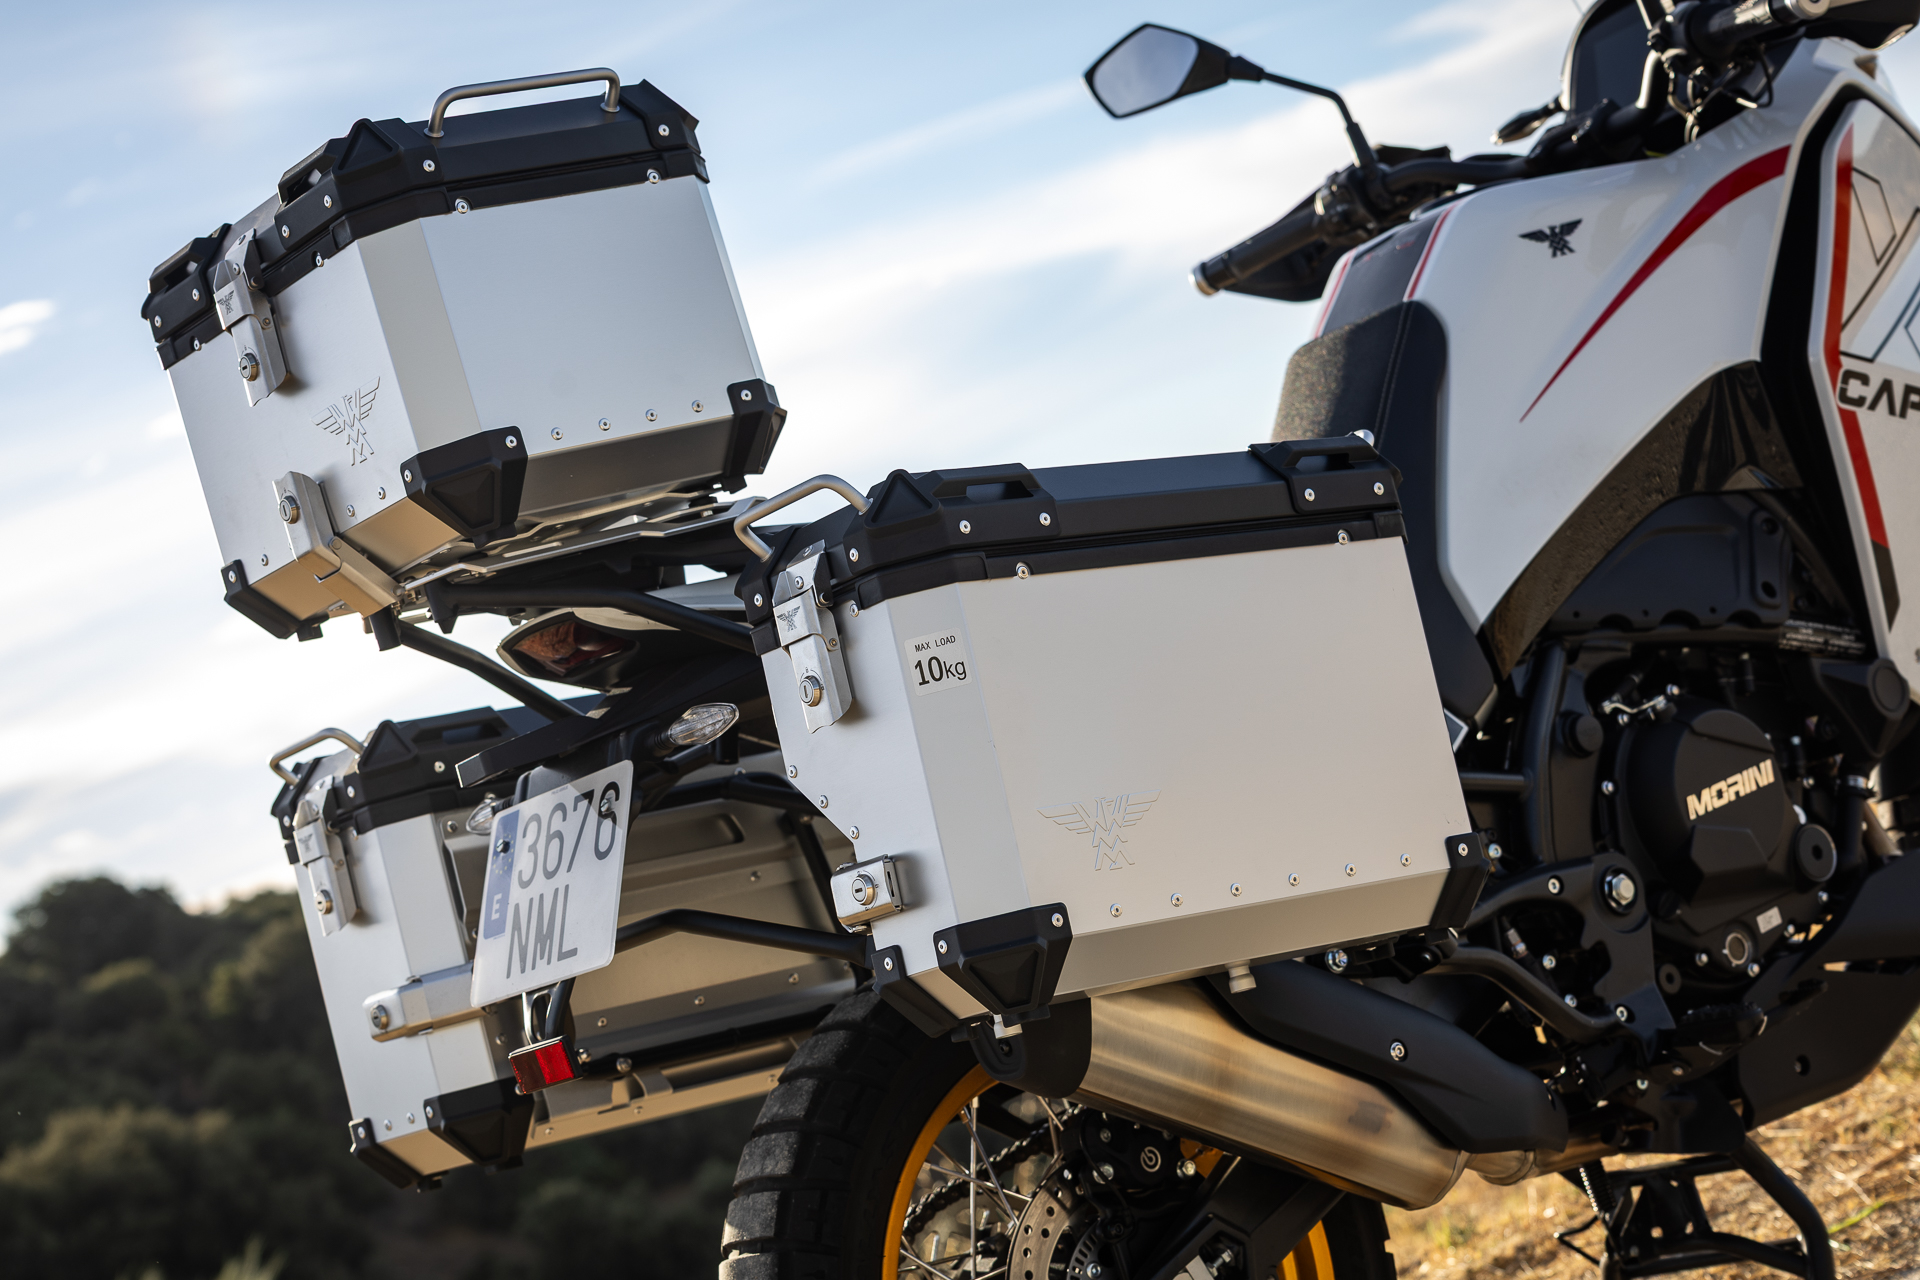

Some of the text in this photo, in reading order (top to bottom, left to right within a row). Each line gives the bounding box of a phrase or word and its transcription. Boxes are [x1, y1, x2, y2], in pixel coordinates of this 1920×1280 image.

[914, 635, 955, 652] MAX LOAD
[914, 656, 967, 686] 10kg
[1686, 758, 1775, 820] MORINI
[517, 781, 621, 889] 3676
[491, 893, 503, 920] E
[506, 884, 578, 979] NML
